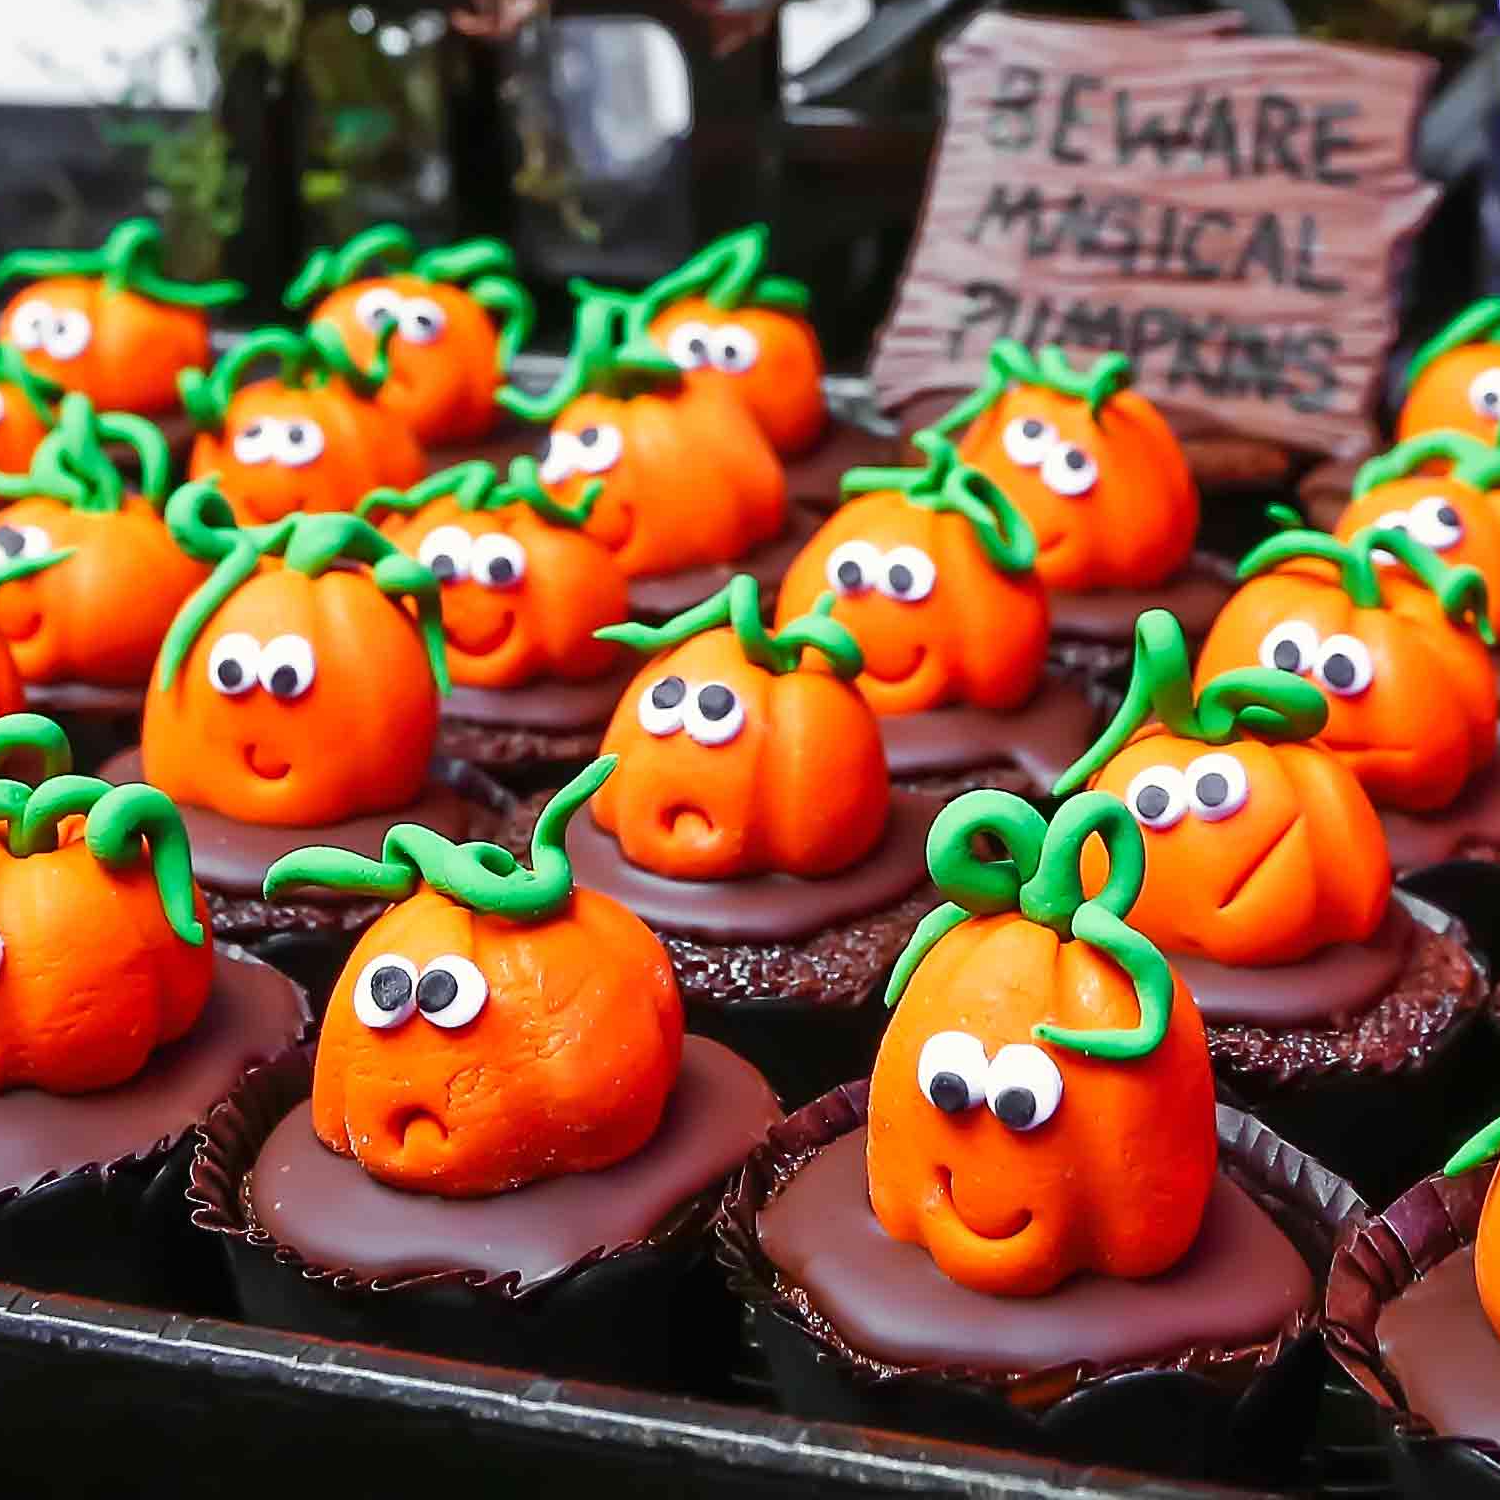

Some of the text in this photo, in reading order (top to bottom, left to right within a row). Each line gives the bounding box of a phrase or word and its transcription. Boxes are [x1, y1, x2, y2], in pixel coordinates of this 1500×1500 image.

[983, 66, 1361, 185] BEWARE
[965, 184, 1345, 293] MAGICAL
[947, 281, 1342, 412] PUMPKINS
